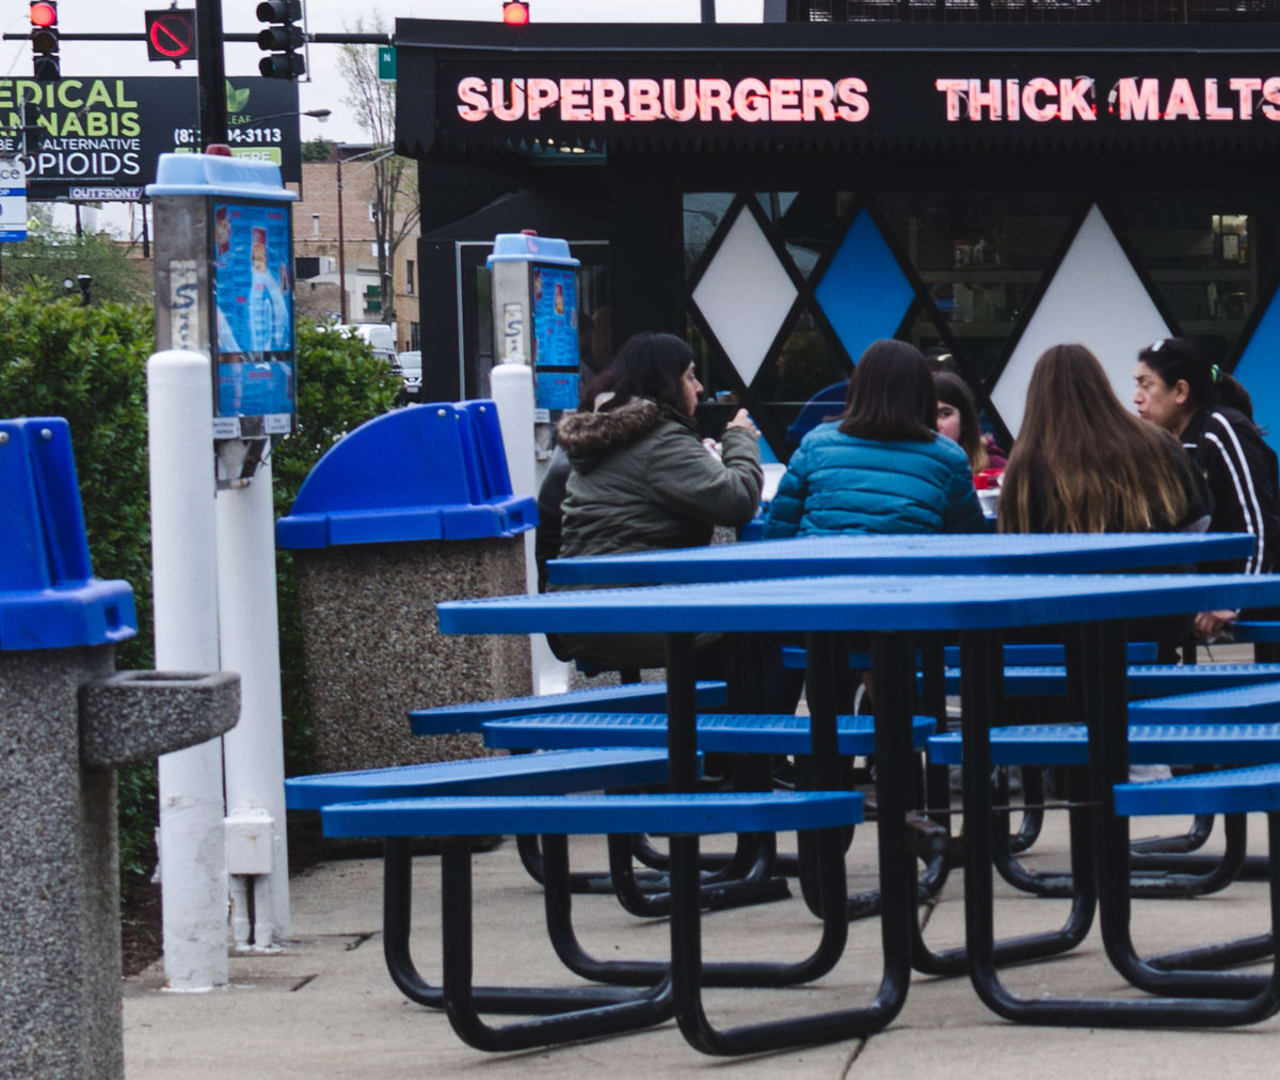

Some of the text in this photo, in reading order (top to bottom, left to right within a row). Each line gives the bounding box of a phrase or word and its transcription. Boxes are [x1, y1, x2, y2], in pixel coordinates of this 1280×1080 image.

[457, 76, 870, 121] SUPERBURGERS
[935, 76, 1097, 121] THICK
[42, 138, 141, 150] ALTERNATIVE
[72, 188, 140, 199] OUTFRONT
